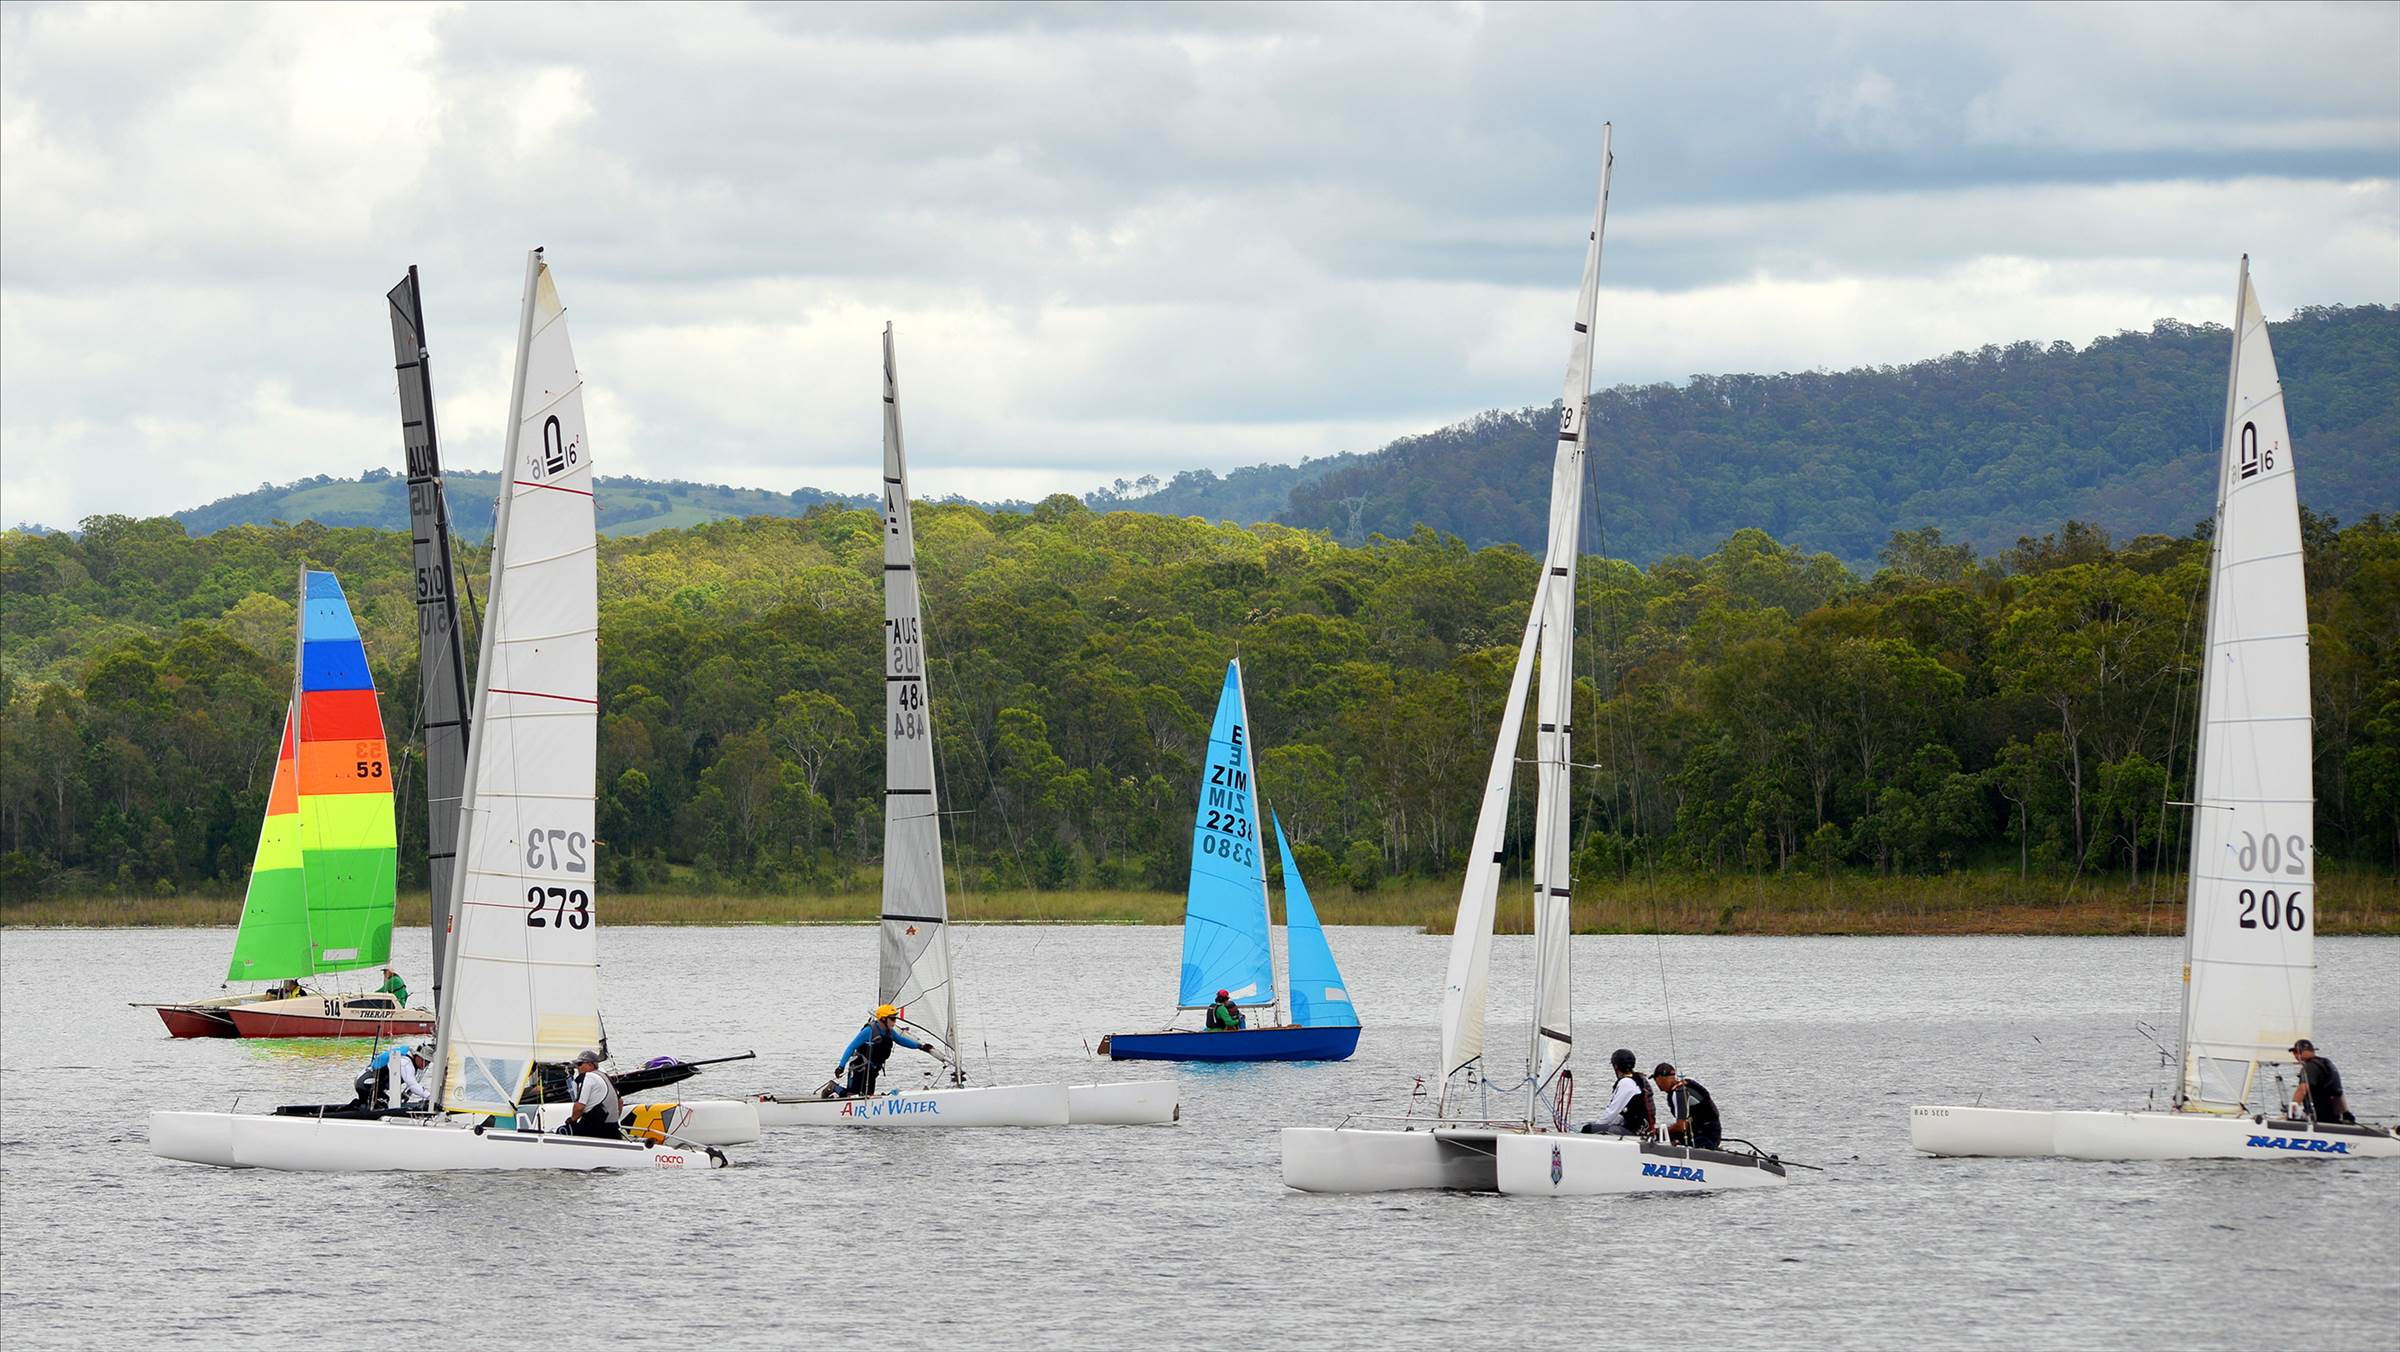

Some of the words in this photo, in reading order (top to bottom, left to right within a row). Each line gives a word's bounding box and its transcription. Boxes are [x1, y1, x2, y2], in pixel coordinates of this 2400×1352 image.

[418, 565, 443, 597] 510
[893, 617, 918, 644] AUS
[1231, 725, 1242, 745] E
[357, 761, 383, 778] 53
[1211, 764, 1247, 792] ZIM
[527, 886, 590, 930] 273
[2239, 888, 2305, 932] 206
[324, 1000, 340, 1017] 514
[360, 1010, 396, 1019] THERAPY
[655, 1154, 684, 1164] nacra
